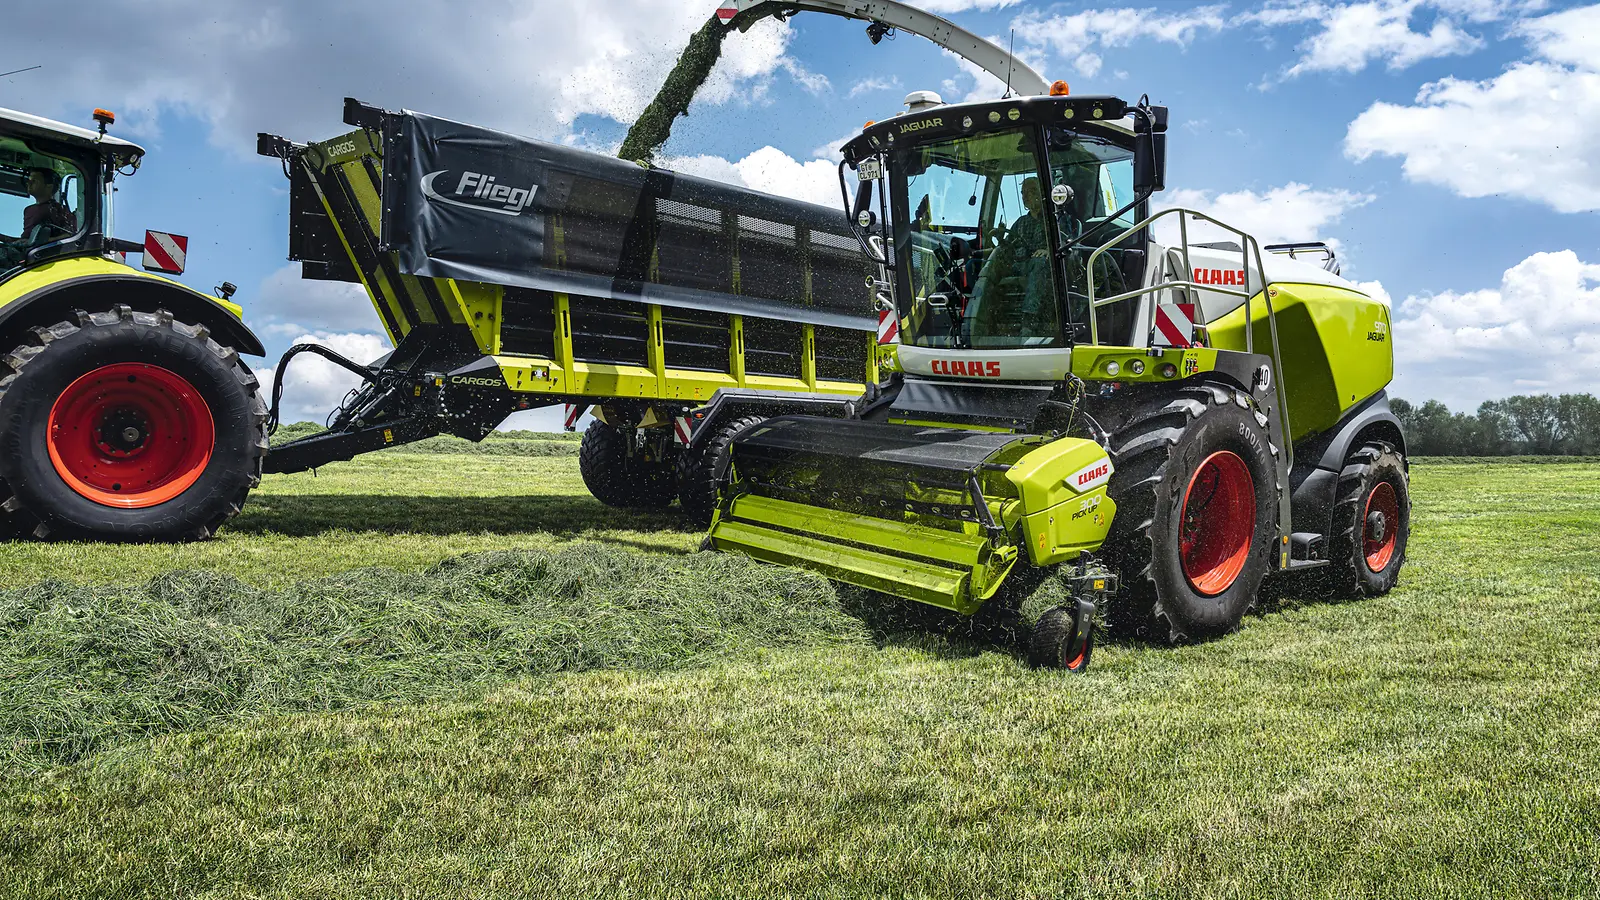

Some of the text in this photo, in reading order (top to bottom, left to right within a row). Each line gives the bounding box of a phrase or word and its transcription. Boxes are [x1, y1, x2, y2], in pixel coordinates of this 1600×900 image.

[900, 118, 943, 134] JAGUAR
[328, 140, 356, 157] CARGOS
[455, 171, 538, 212] Fliegl
[1194, 268, 1245, 285] CLAAS
[1367, 332, 1384, 342] JAGUAR
[931, 359, 1000, 377] CLAAS
[451, 376, 502, 387] CARGOS
[1239, 422, 1266, 465] 800/70
[1078, 464, 1108, 486] CLAAS
[1080, 494, 1102, 511] 300
[1072, 504, 1098, 521] PICK UP
